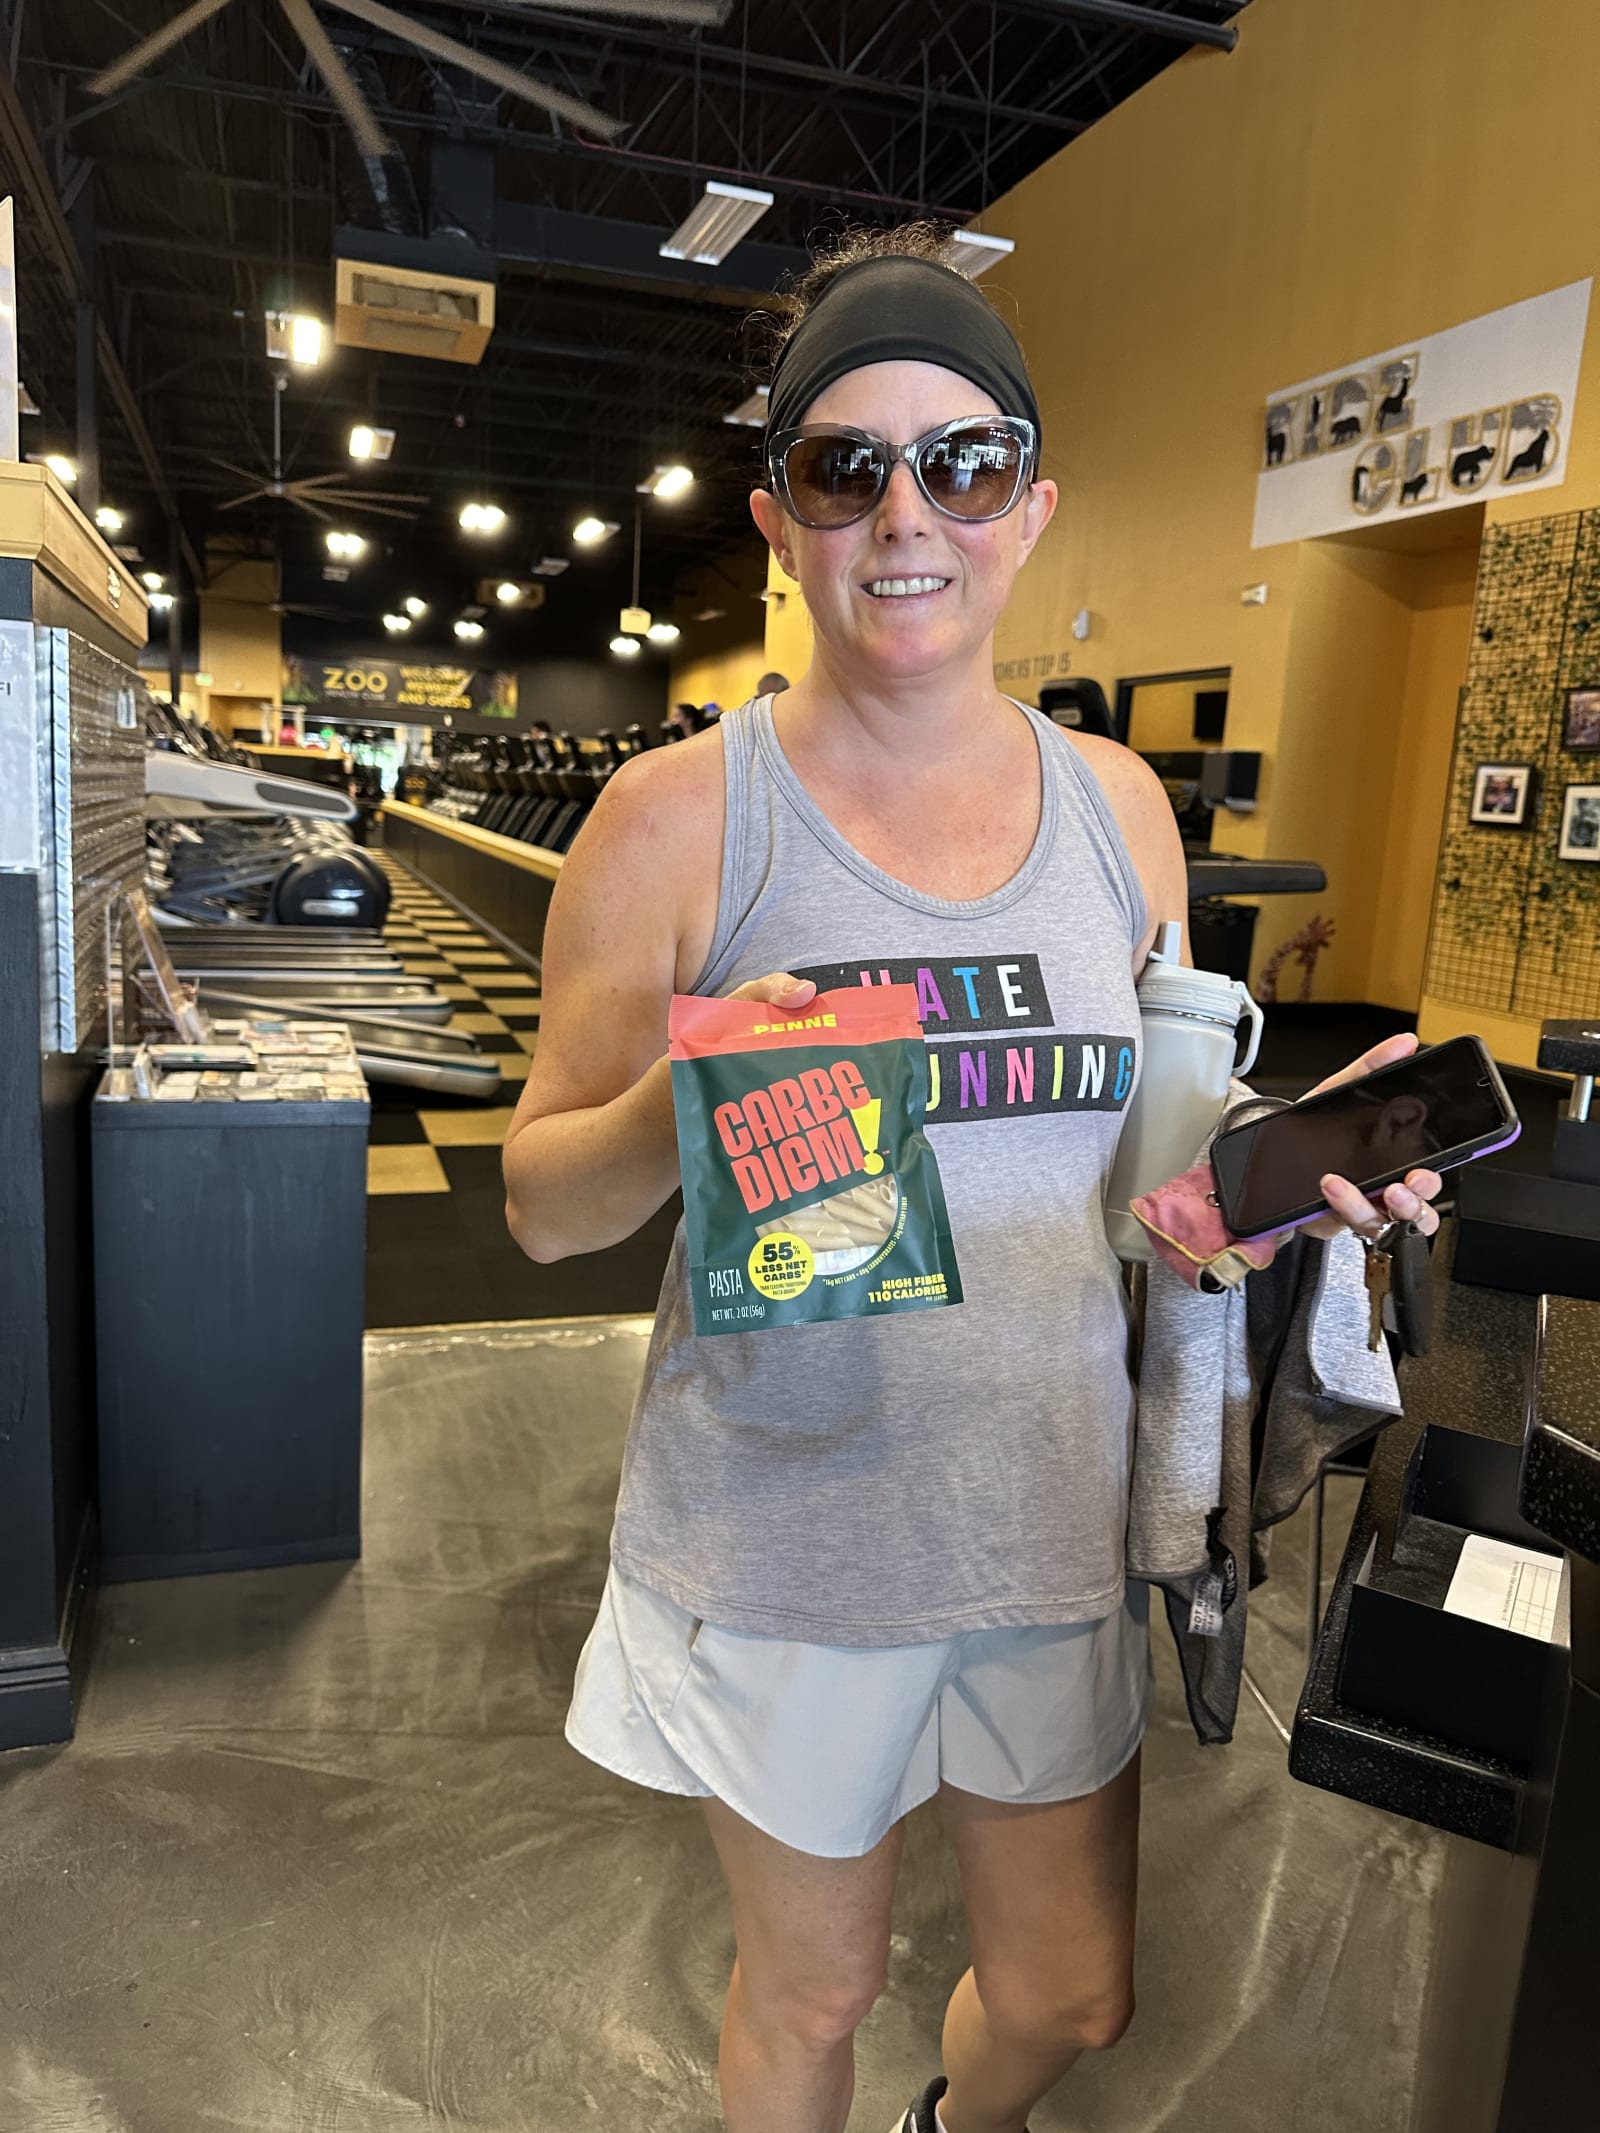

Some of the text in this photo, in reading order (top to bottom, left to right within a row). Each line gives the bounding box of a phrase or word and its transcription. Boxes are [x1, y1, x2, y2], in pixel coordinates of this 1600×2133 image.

[323, 667, 388, 693] ZOO
[398, 690, 426, 705] AND
[754, 1013, 837, 1035] PENNE
[763, 1241, 800, 1263] 55%
[755, 1260, 808, 1274] LESS NET
[708, 1268, 744, 1298] PASTA
[881, 1273, 945, 1290] HIGH FIBER
[867, 1284, 948, 1303] 110 CALORIES
[712, 1309, 723, 1321] NET
[724, 1308, 735, 1320] WT.
[736, 1307, 741, 1319] 2
[741, 1306, 749, 1318] OZ
